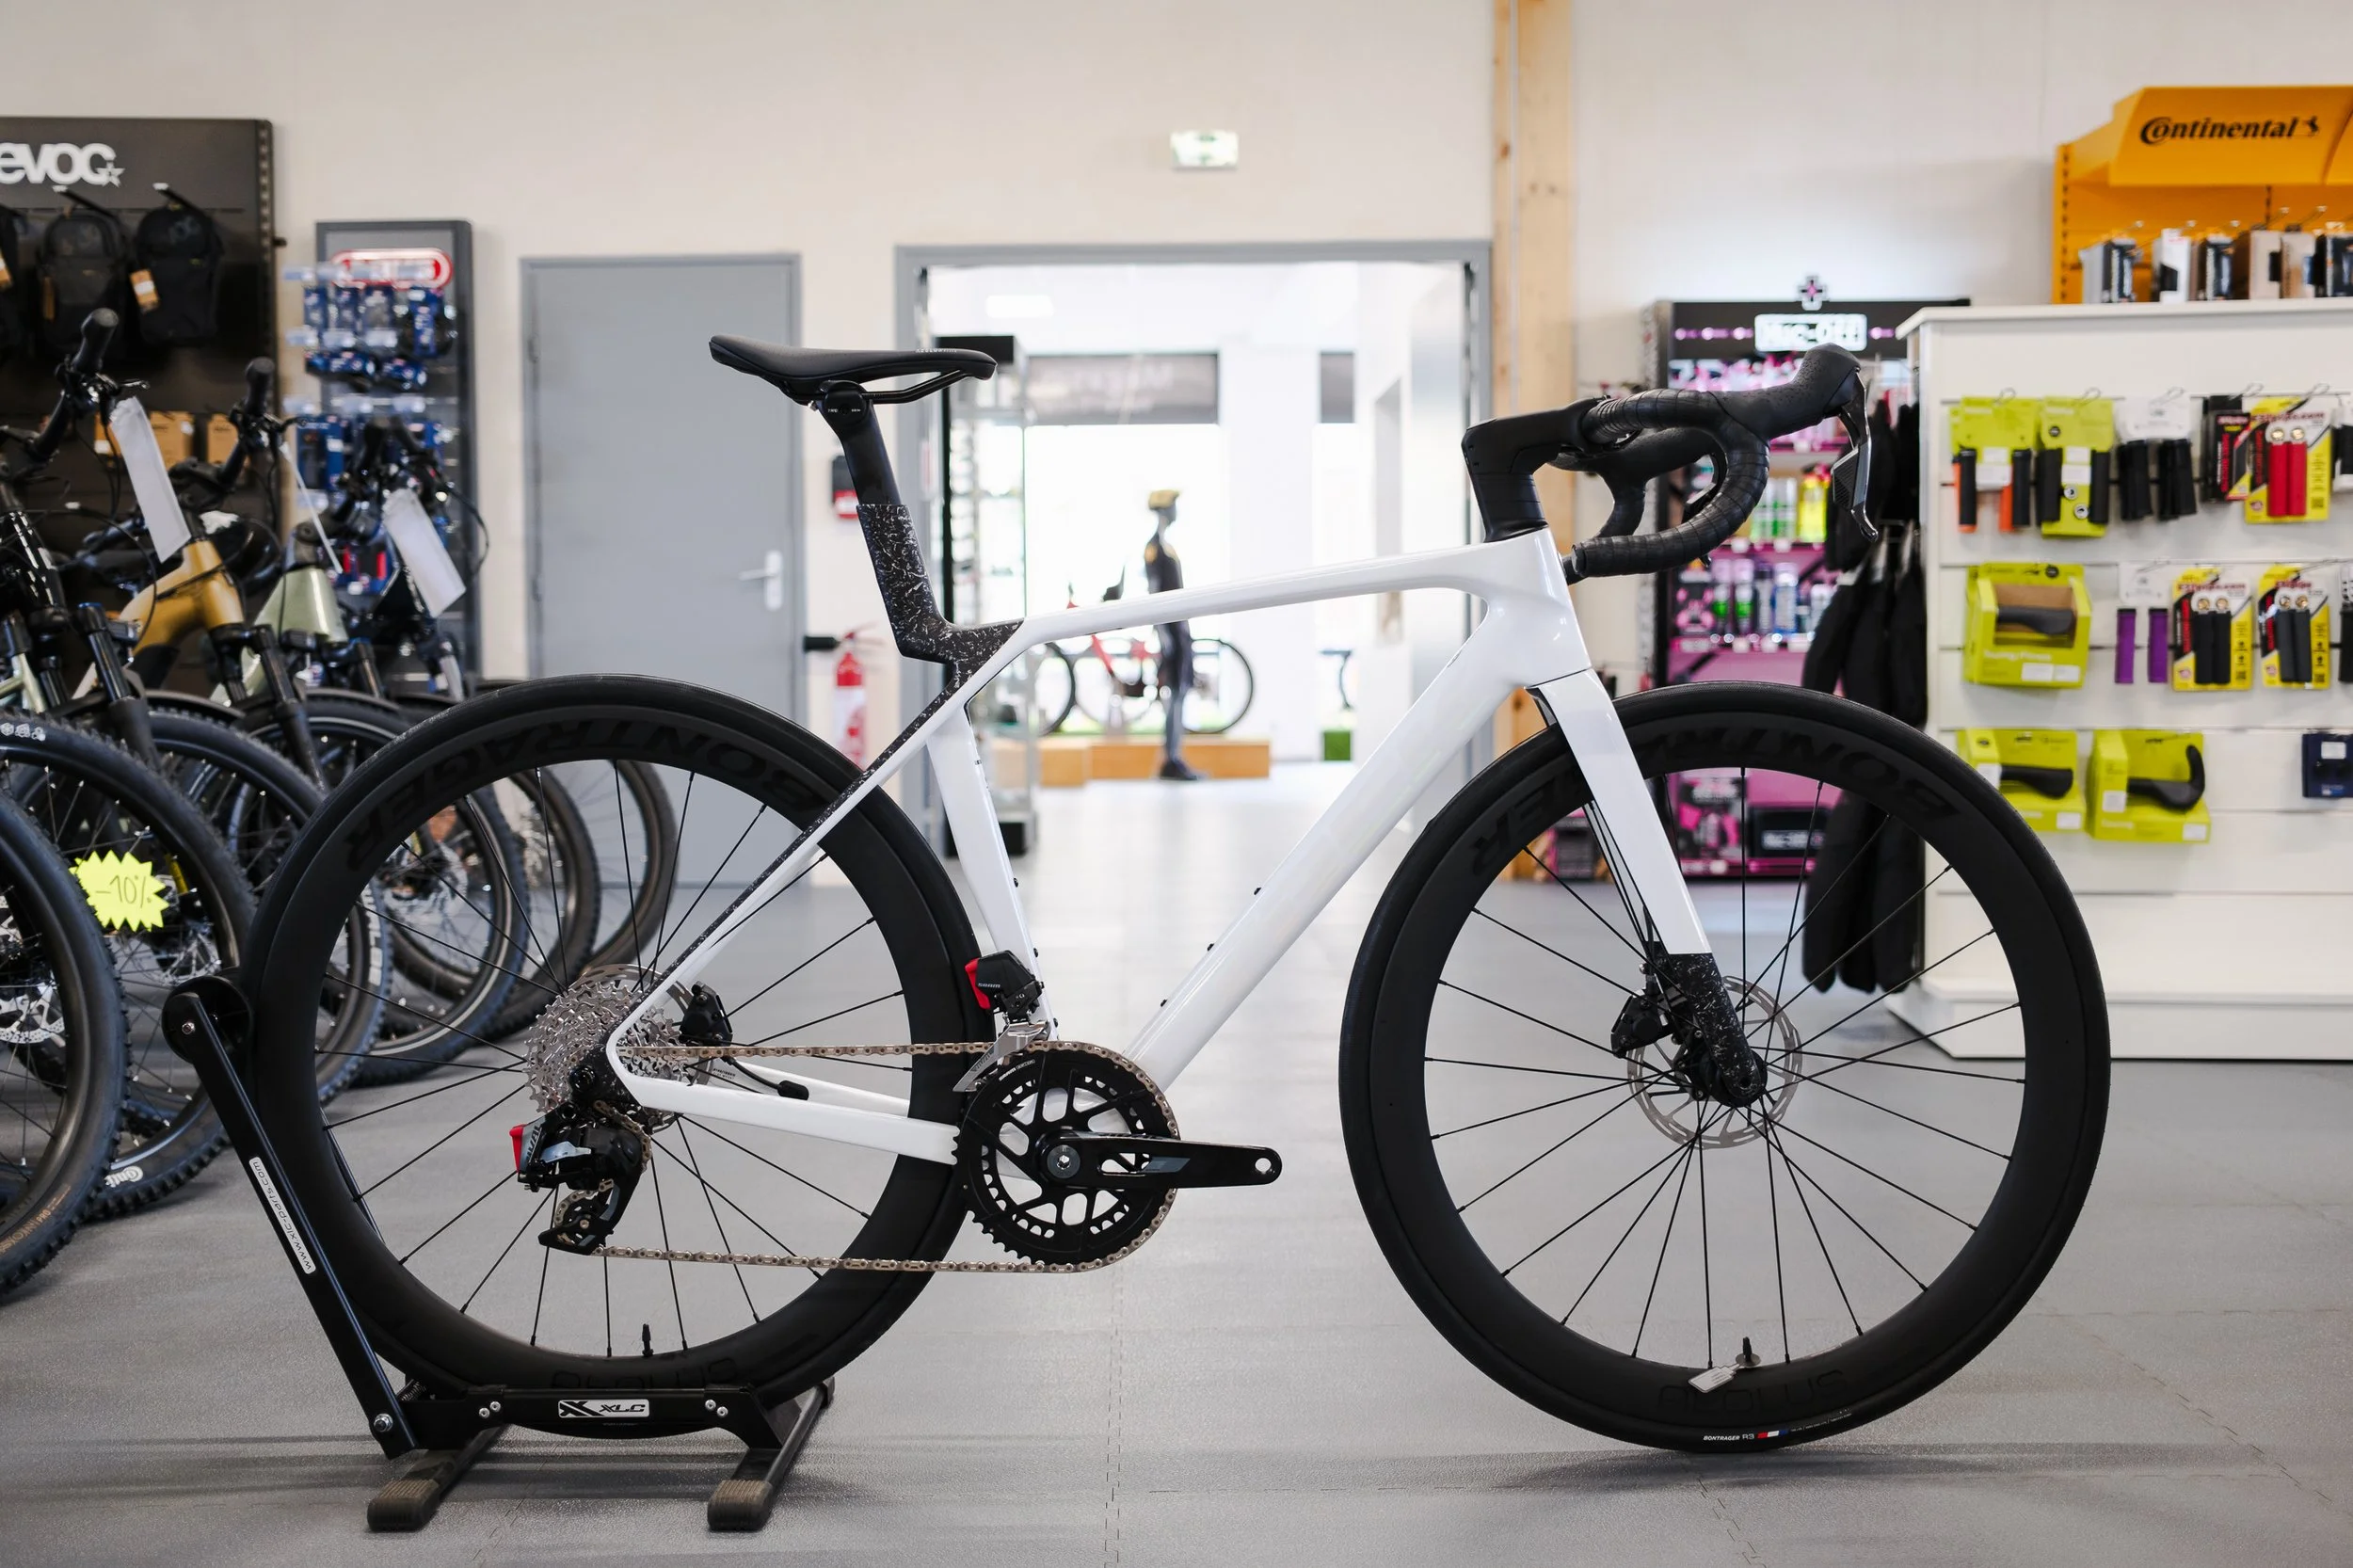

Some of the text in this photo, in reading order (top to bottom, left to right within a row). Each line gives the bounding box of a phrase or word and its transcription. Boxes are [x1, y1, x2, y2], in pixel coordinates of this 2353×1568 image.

[2139, 117, 2299, 145] Continental
[1470, 728, 1961, 877] BONTRER
[95, 874, 152, 909] -10%
[252, 1161, 312, 1271] www.xlc-parts.com
[599, 1403, 647, 1414] XLC
